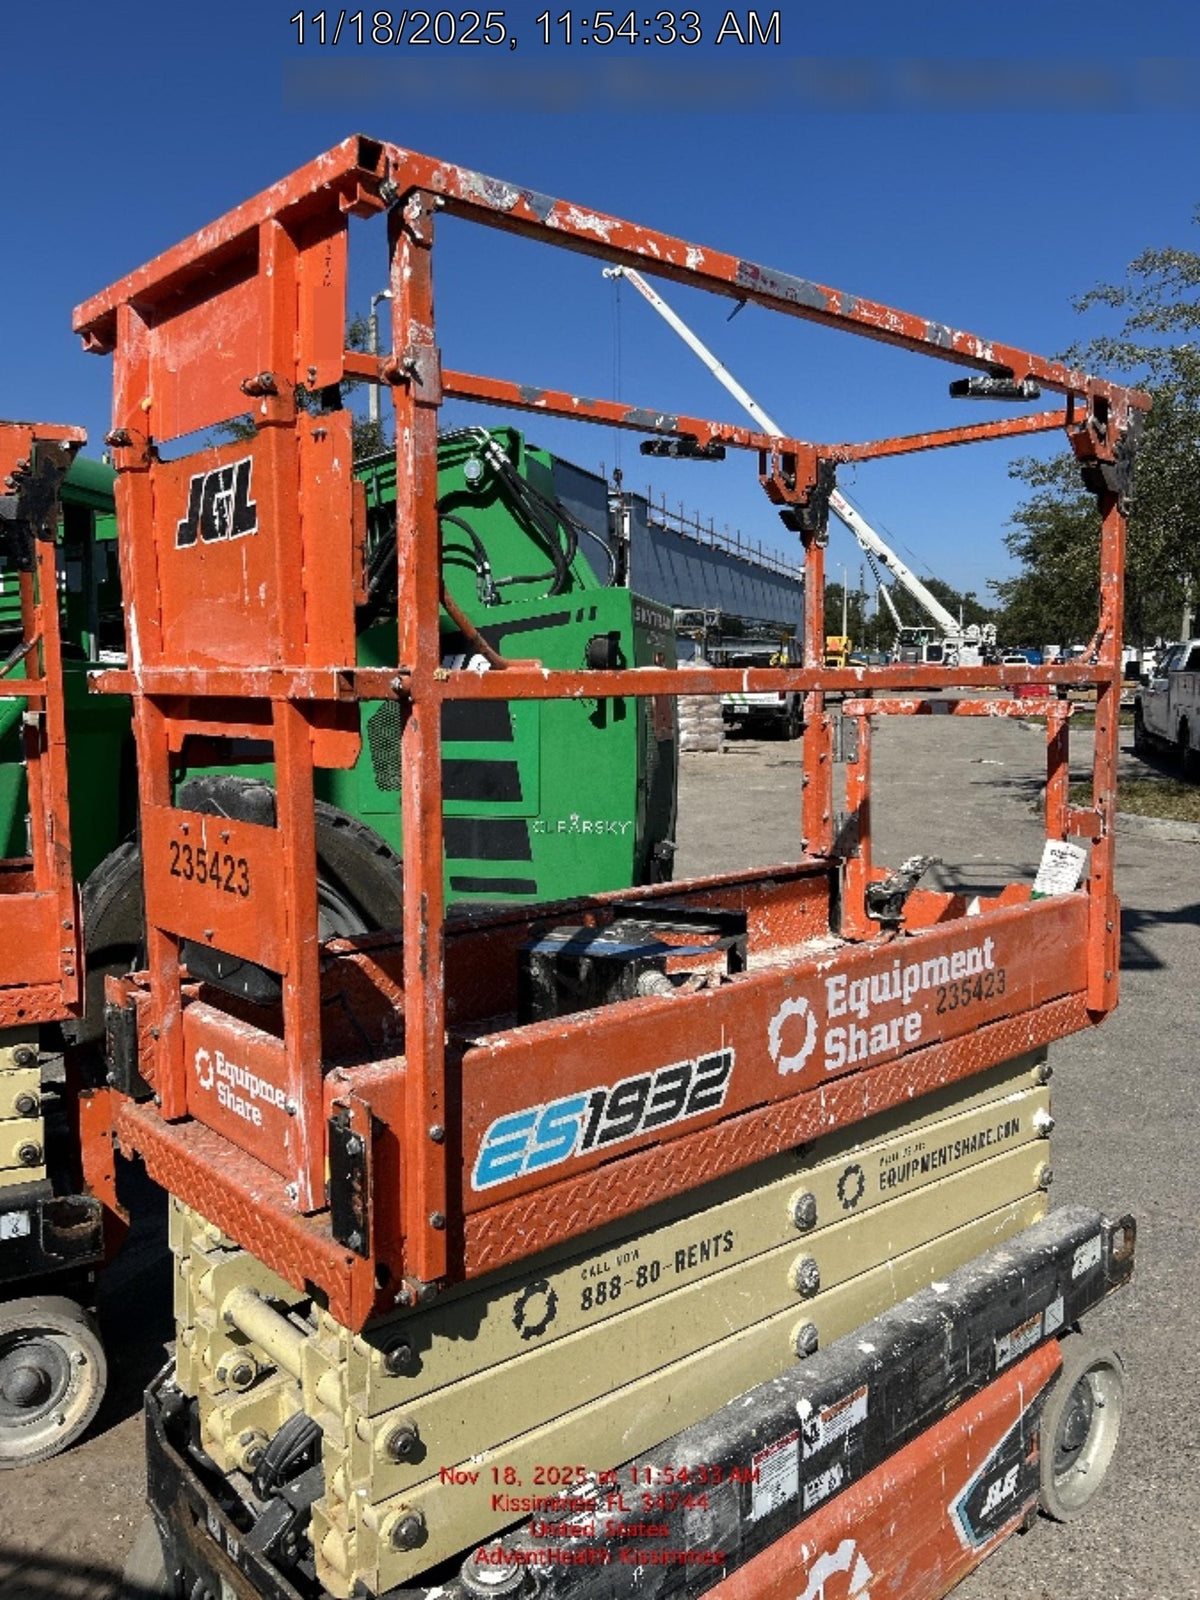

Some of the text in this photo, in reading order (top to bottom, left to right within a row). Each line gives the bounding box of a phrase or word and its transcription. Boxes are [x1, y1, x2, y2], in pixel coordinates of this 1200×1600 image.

[532, 819, 633, 836] CLEARSKY
[169, 840, 250, 898] 235423
[825, 936, 995, 1020] Equipment
[935, 968, 1006, 1016] 235423
[824, 1010, 922, 1071] Share
[214, 1049, 287, 1110] Equipme
[216, 1079, 263, 1127] Share
[580, 1229, 734, 1311] 888-80-RENTS
[580, 1261, 611, 1281] CALL
